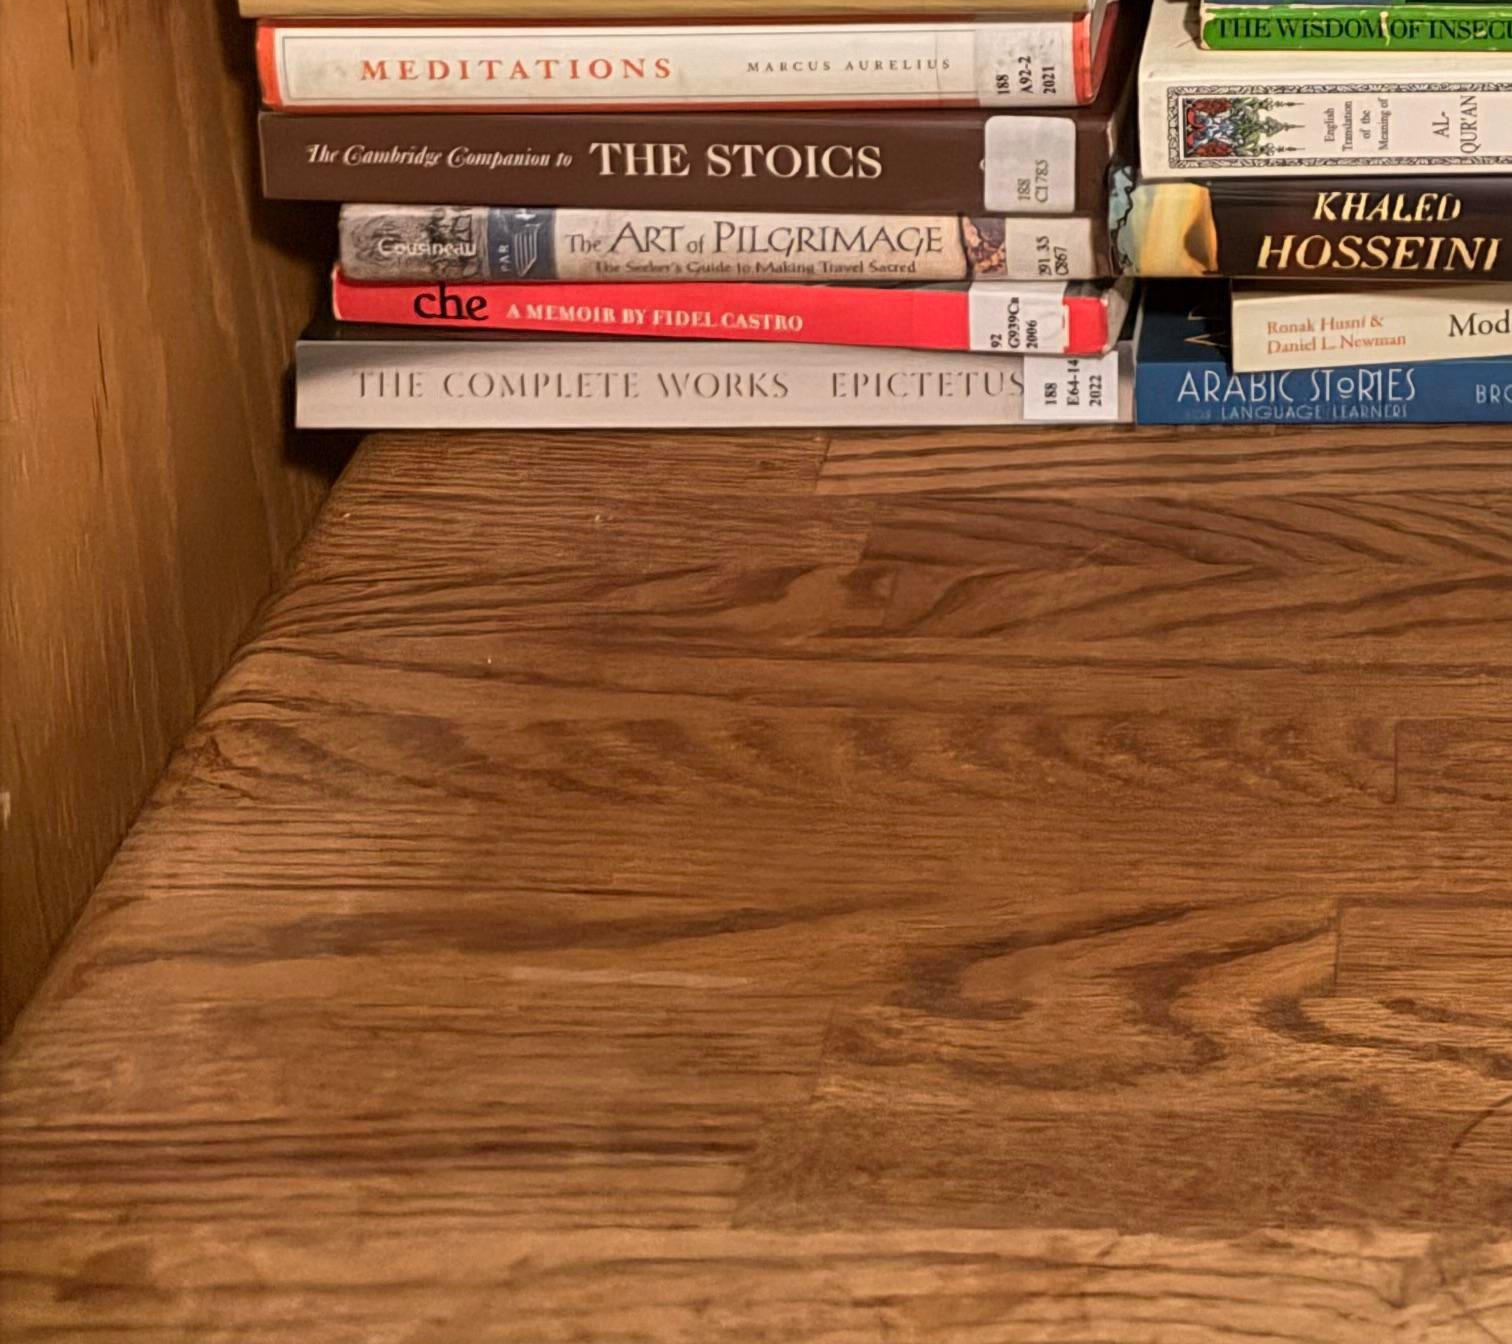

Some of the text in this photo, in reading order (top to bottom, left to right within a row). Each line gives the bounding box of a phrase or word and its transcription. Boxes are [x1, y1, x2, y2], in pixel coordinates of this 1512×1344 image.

[361, 59, 670, 80] MEDITATIONS
[748, 59, 949, 72] MARCUS AURELIUS
[414, 281, 488, 322] che
[507, 304, 802, 331] A MEMOIR BY FIDEL CASTRO
[1026, 320, 1038, 348] 2006
